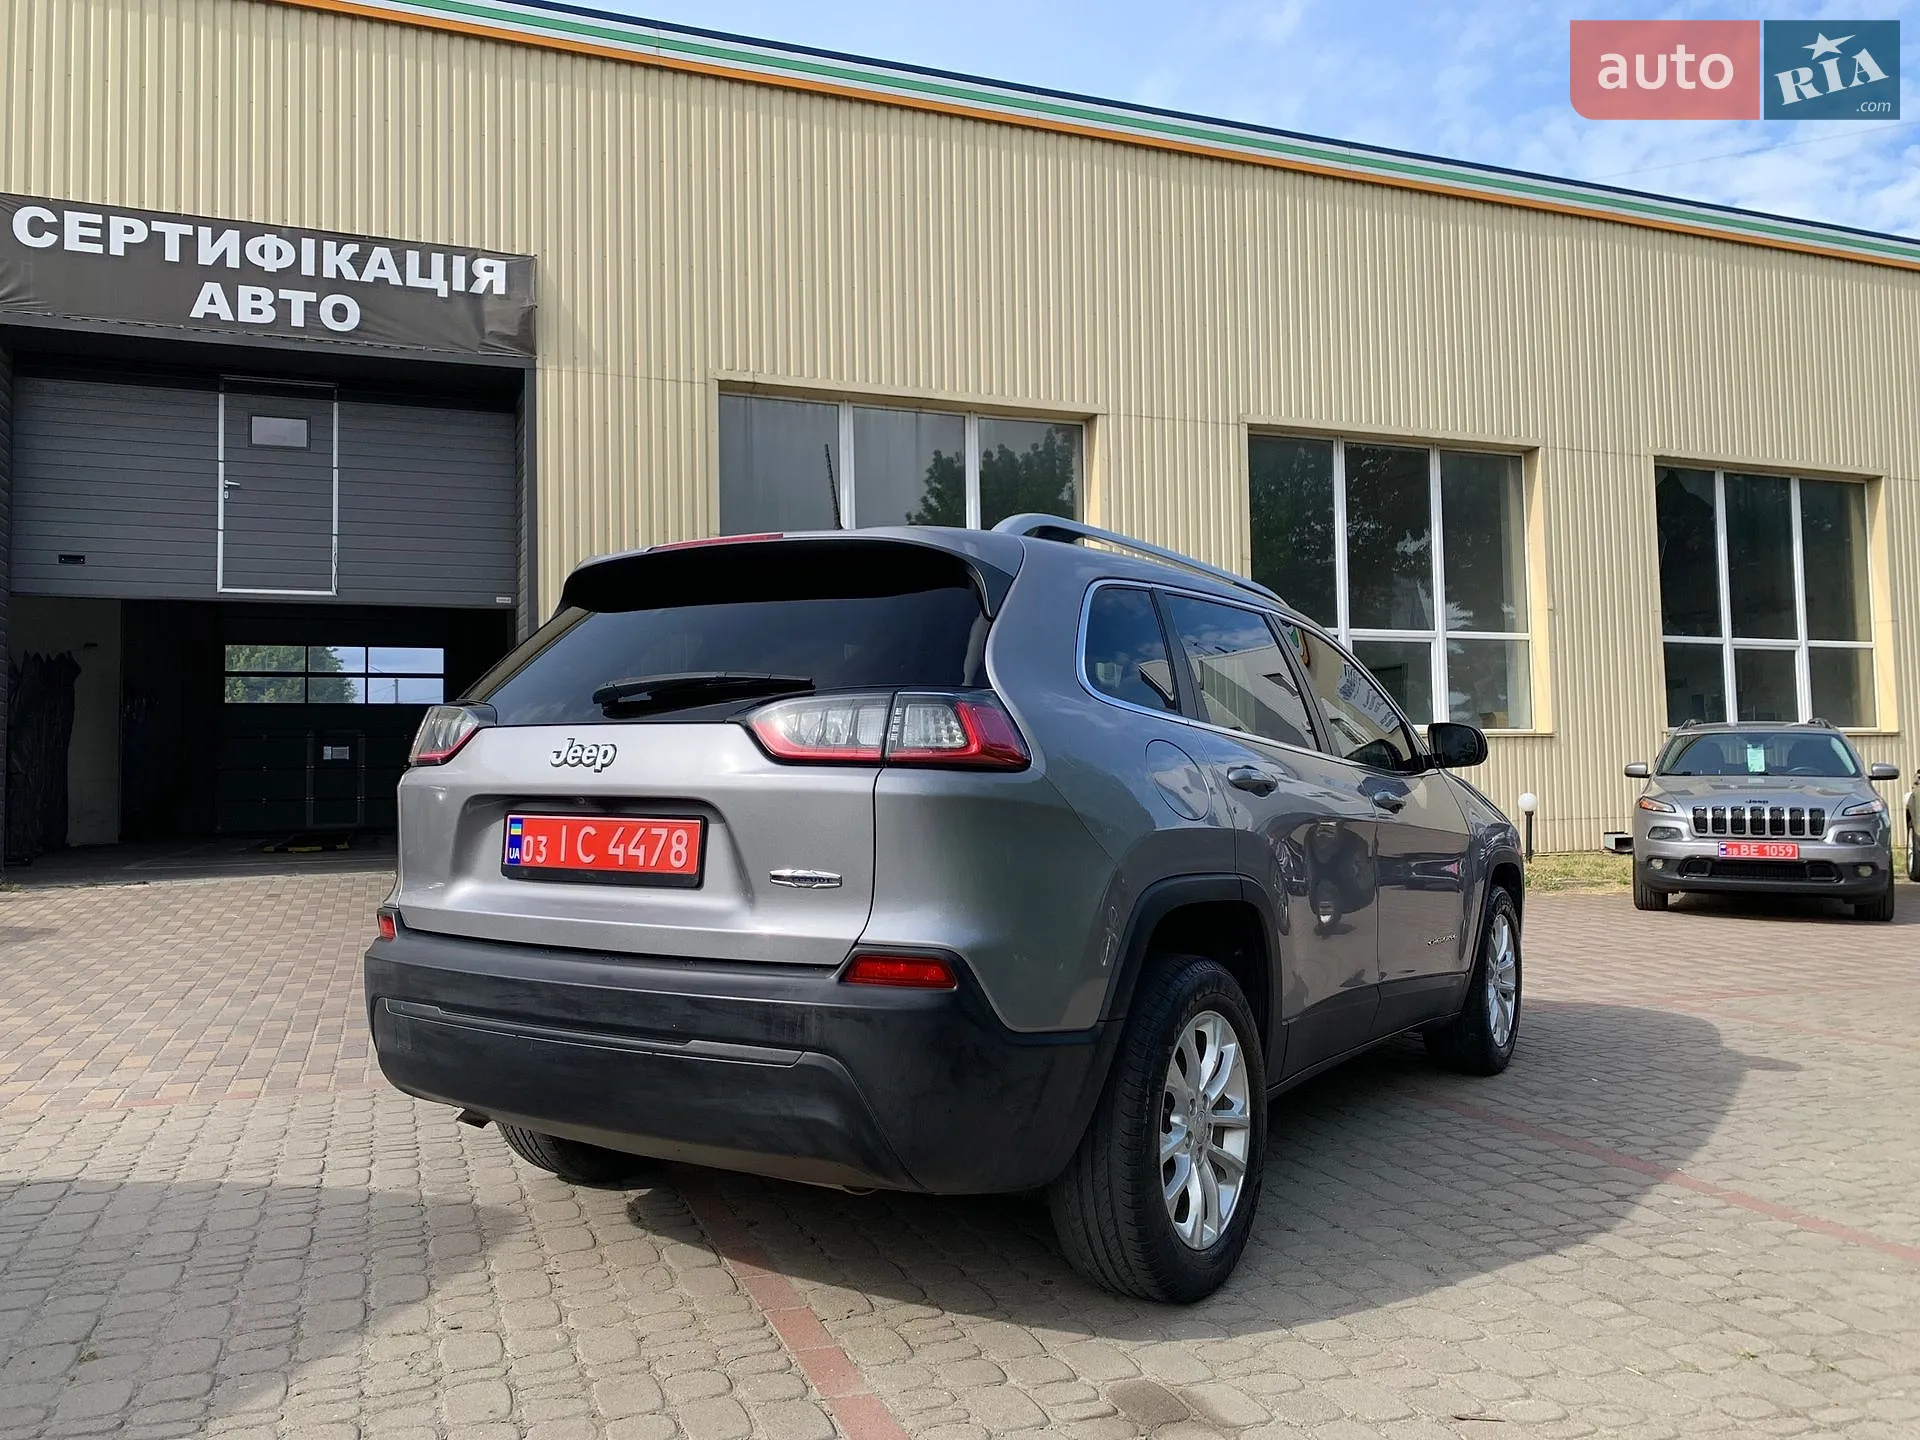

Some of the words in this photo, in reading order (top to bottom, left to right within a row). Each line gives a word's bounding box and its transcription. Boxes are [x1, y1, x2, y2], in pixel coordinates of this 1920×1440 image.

[11, 205, 507, 298] СЕРТИФІКАЦІЯ
[188, 281, 361, 333] АВТО
[549, 737, 618, 774] Jeep
[508, 848, 520, 860] UA
[522, 835, 548, 864] 03
[607, 826, 689, 869] 4478
[1740, 844, 1760, 856] BE
[1763, 845, 1793, 857] 1059
